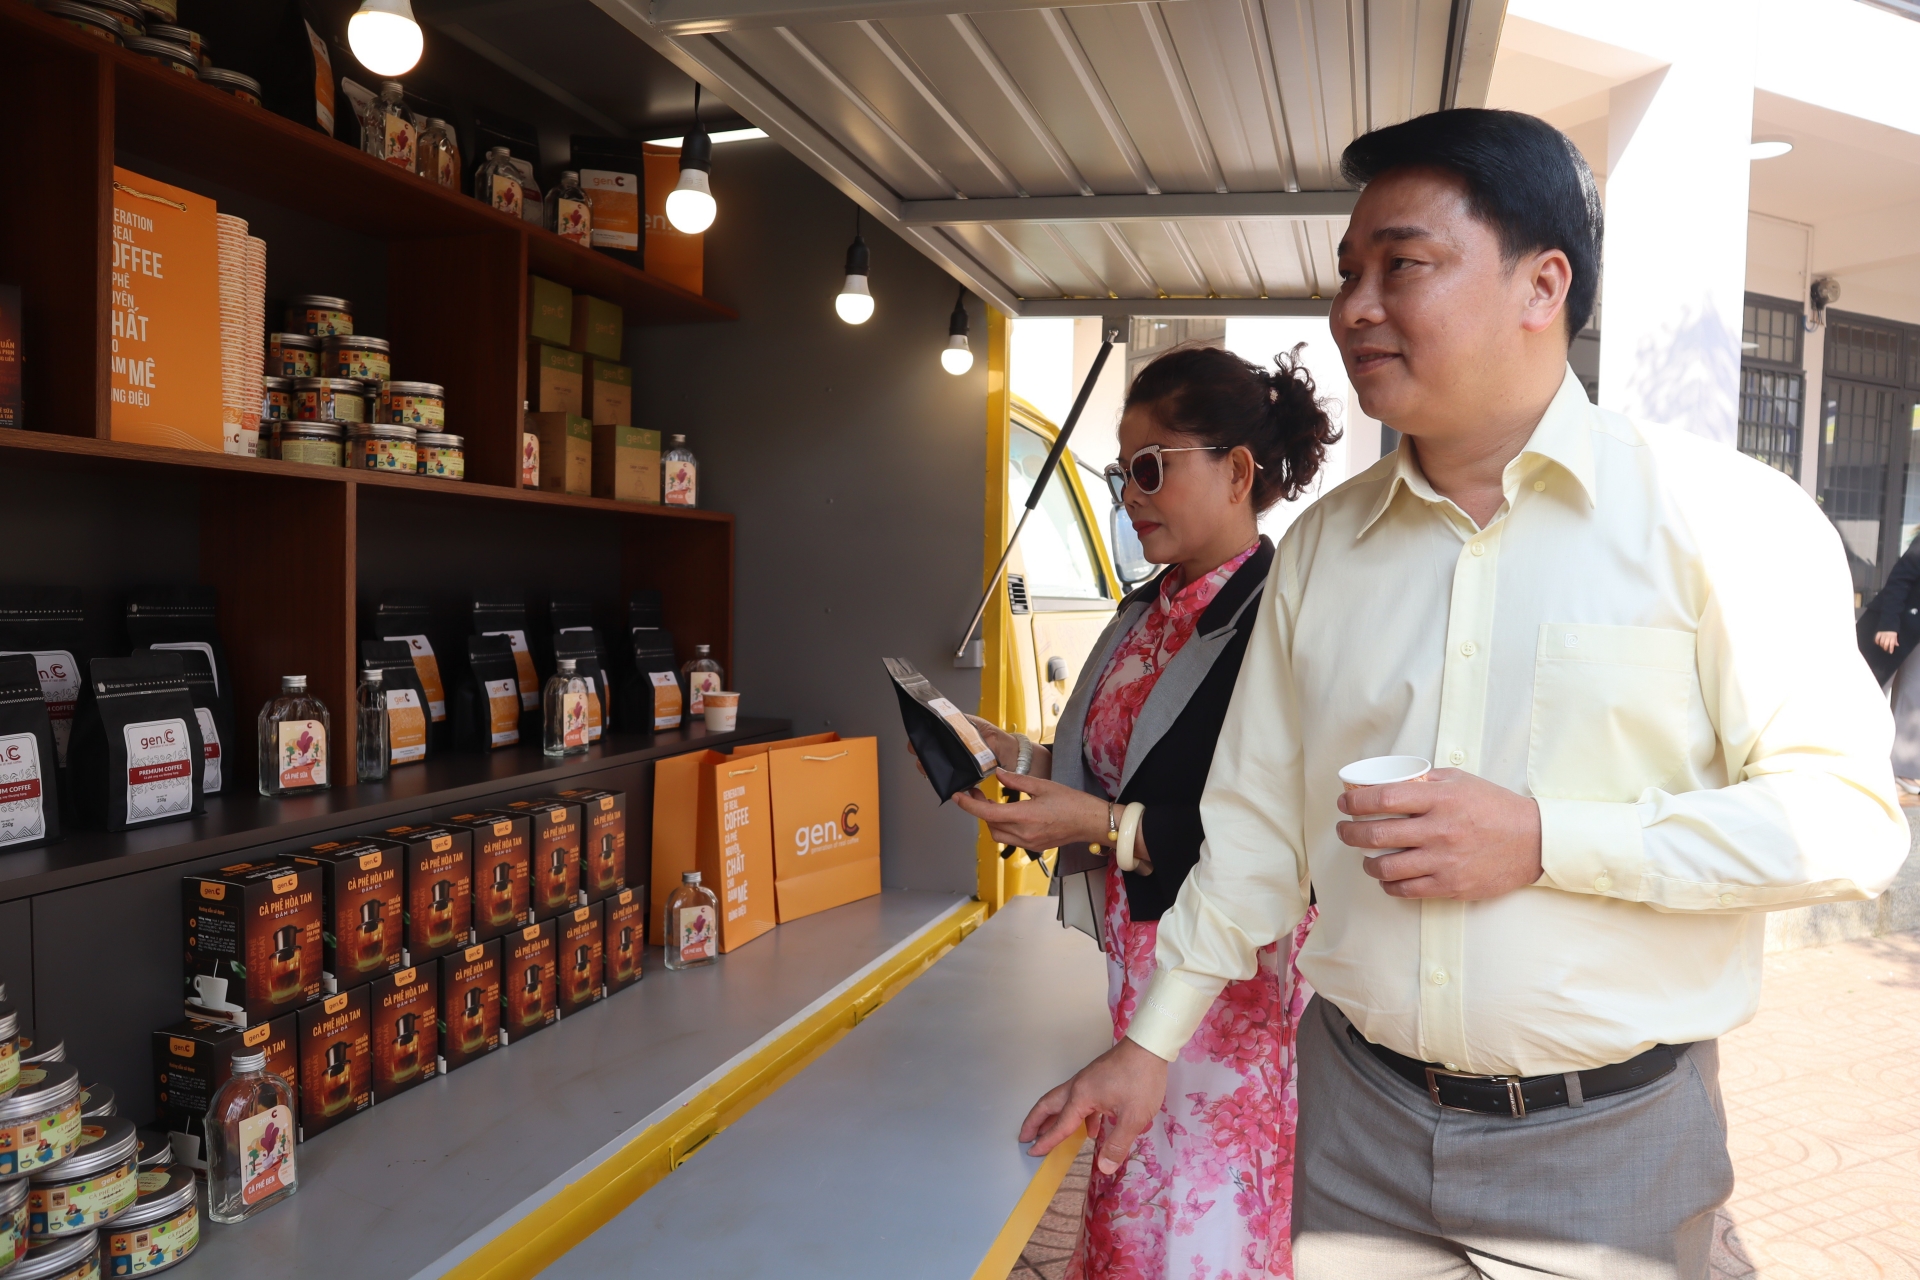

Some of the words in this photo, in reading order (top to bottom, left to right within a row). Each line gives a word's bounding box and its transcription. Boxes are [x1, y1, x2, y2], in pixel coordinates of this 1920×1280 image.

[593, 176, 624, 186] gen.C
[114, 208, 153, 232] ERATION
[113, 241, 163, 279] OFFEE
[112, 307, 149, 342] HẤT
[129, 357, 156, 389] MÊ
[38, 664, 66, 679] n.C
[140, 729, 175, 749] gen.C
[139, 767, 163, 776] PREMIUM
[9, 784, 31, 792] COFFEE
[725, 806, 749, 831] COFFEE
[795, 803, 859, 856] gen.C
[727, 852, 745, 878] CHẤT
[348, 877, 357, 890] CÀ
[358, 873, 369, 889] PHÊ
[383, 869, 394, 880] TAN
[259, 901, 269, 916] CÀ
[271, 896, 284, 912] PHÊ
[285, 896, 298, 909] HÒA
[300, 892, 312, 905] TAN
[313, 1022, 322, 1037] CÀ
[323, 1018, 334, 1032] PHÊ
[349, 1008, 360, 1021] TAN
[249, 1029, 265, 1043] gen.C
[273, 1039, 285, 1053] TAN
[174, 1044, 190, 1052] gen.C
[99, 1188, 109, 1196] PHÊ
[248, 1185, 255, 1194] CÀ
[255, 1181, 265, 1191] PHÊ
